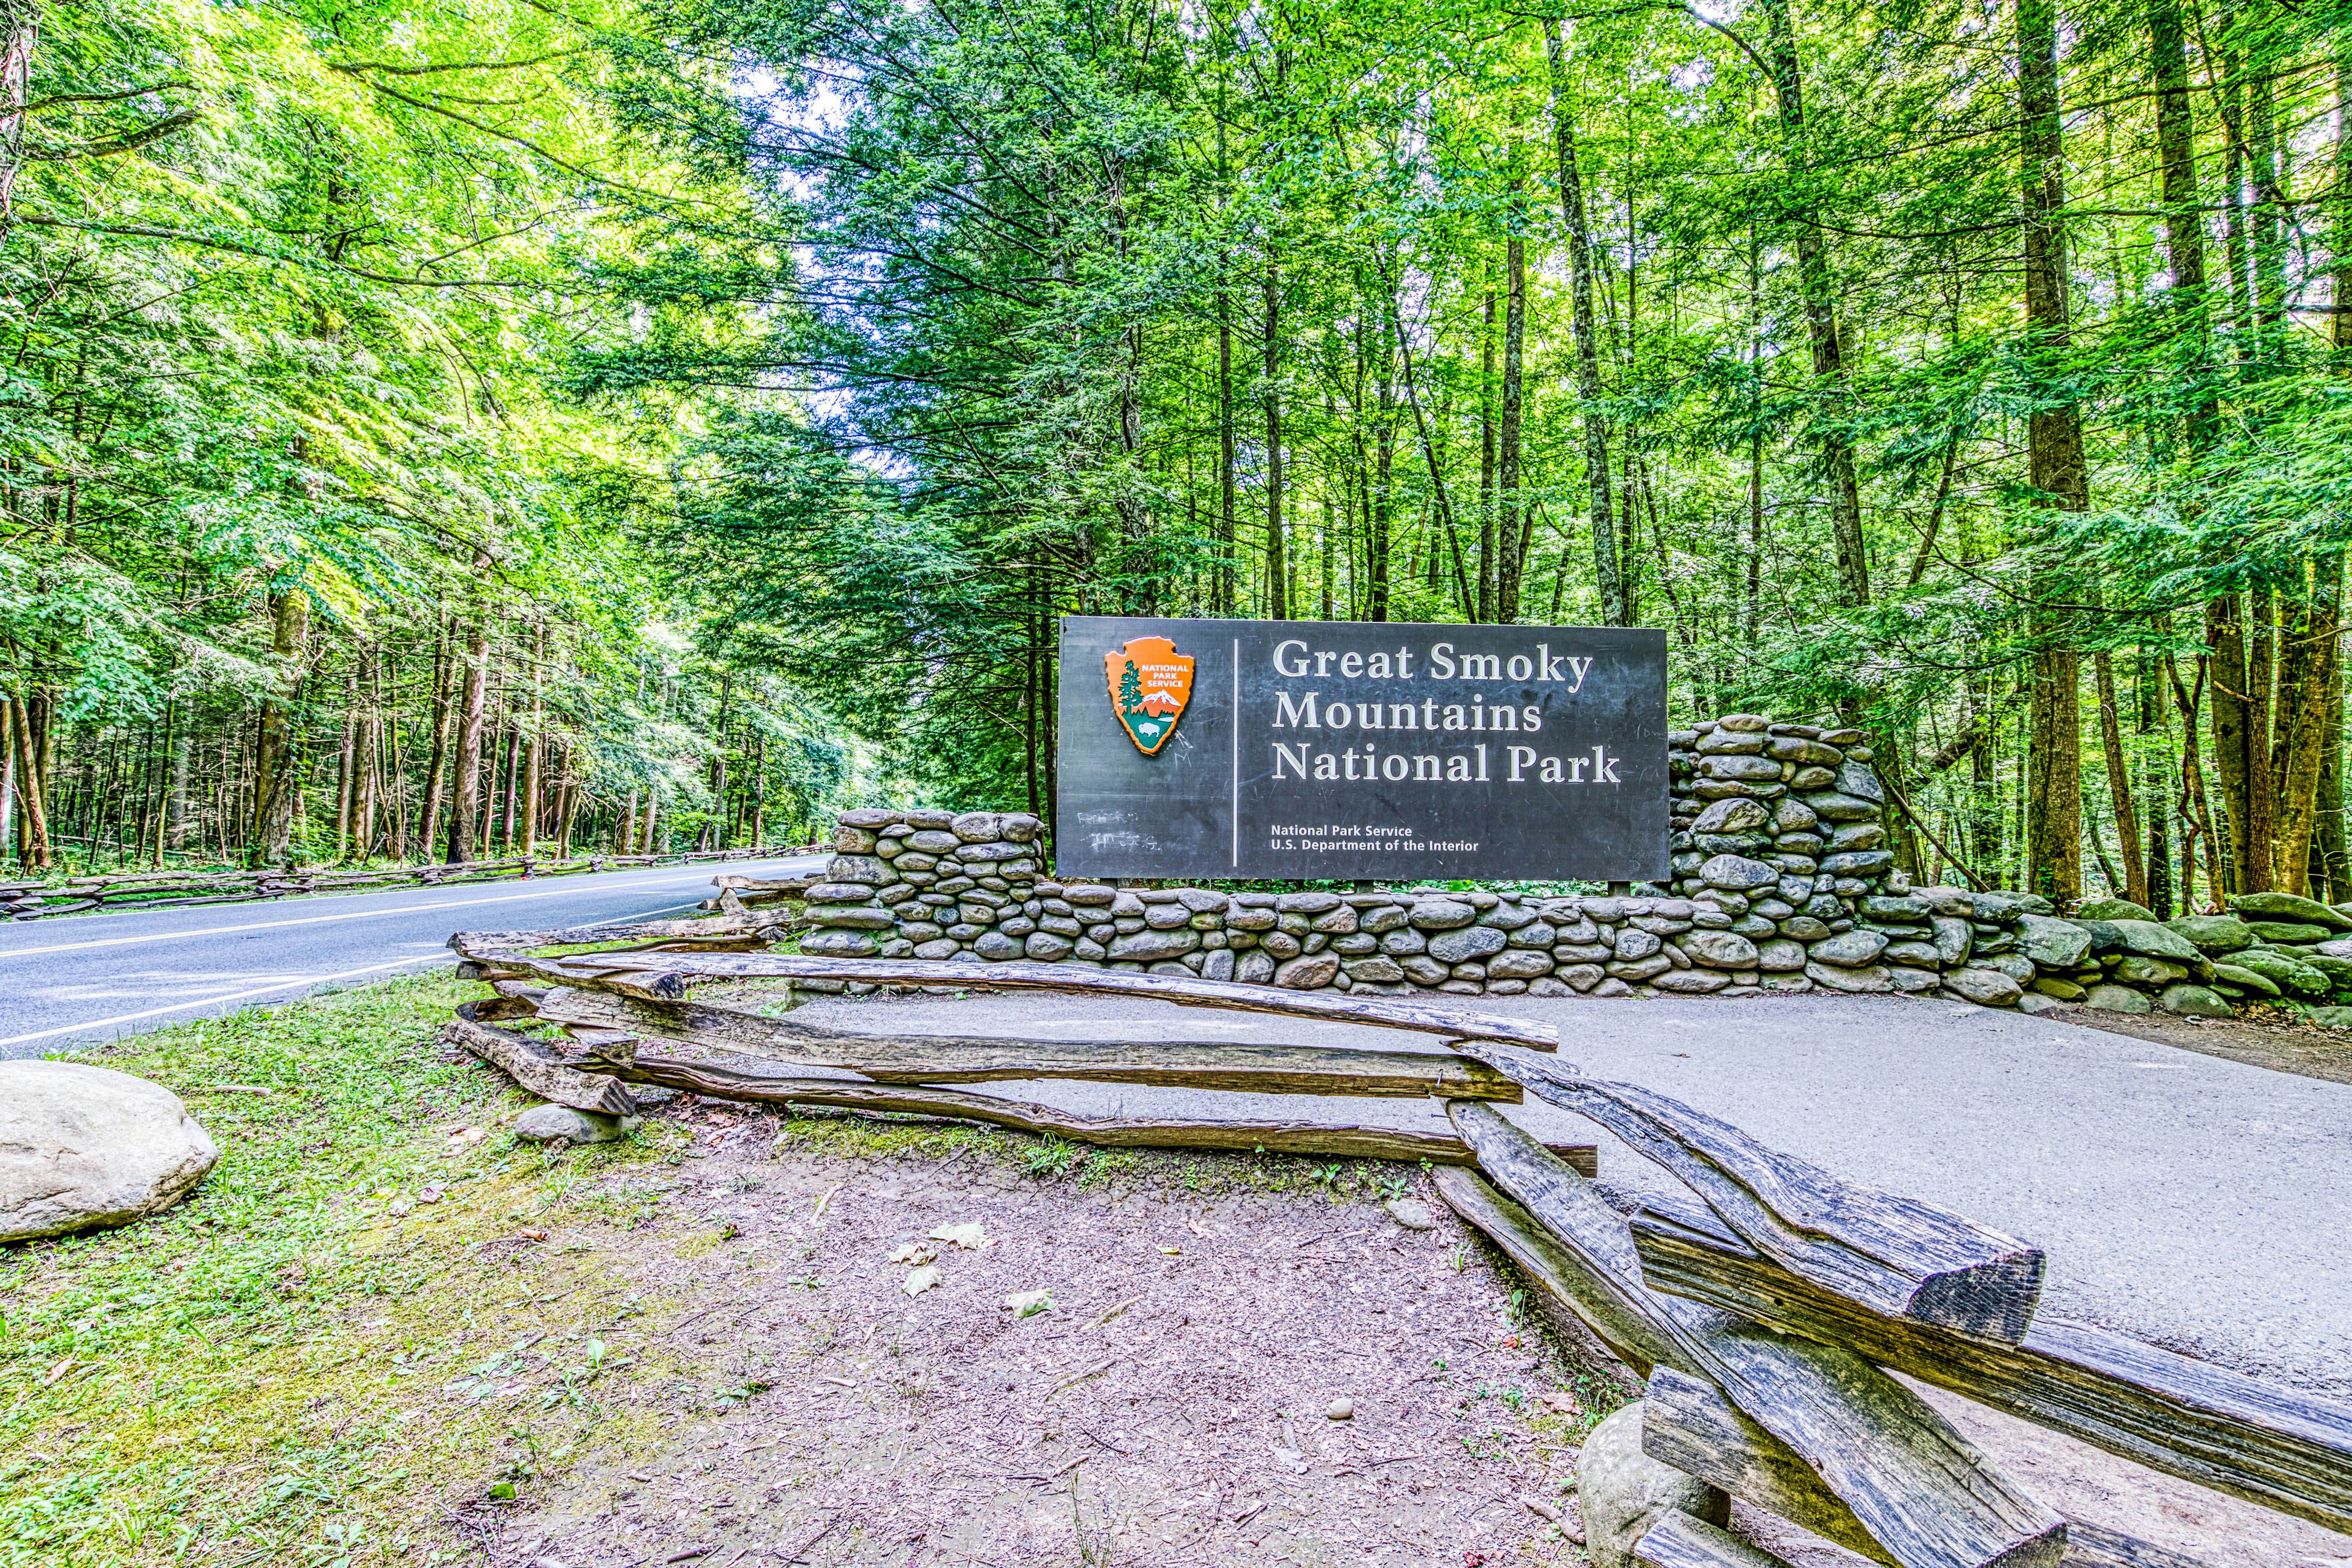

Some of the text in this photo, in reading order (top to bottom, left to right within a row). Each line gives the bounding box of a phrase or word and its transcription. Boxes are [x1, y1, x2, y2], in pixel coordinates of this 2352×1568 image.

[1273, 639, 1593, 693] Great Smoky
[1272, 691, 1541, 732] Mountains
[1272, 742, 1621, 783] National Park
[1271, 824, 1413, 836] National Park Service
[1271, 839, 1479, 853] U.S. Department of the Interior
